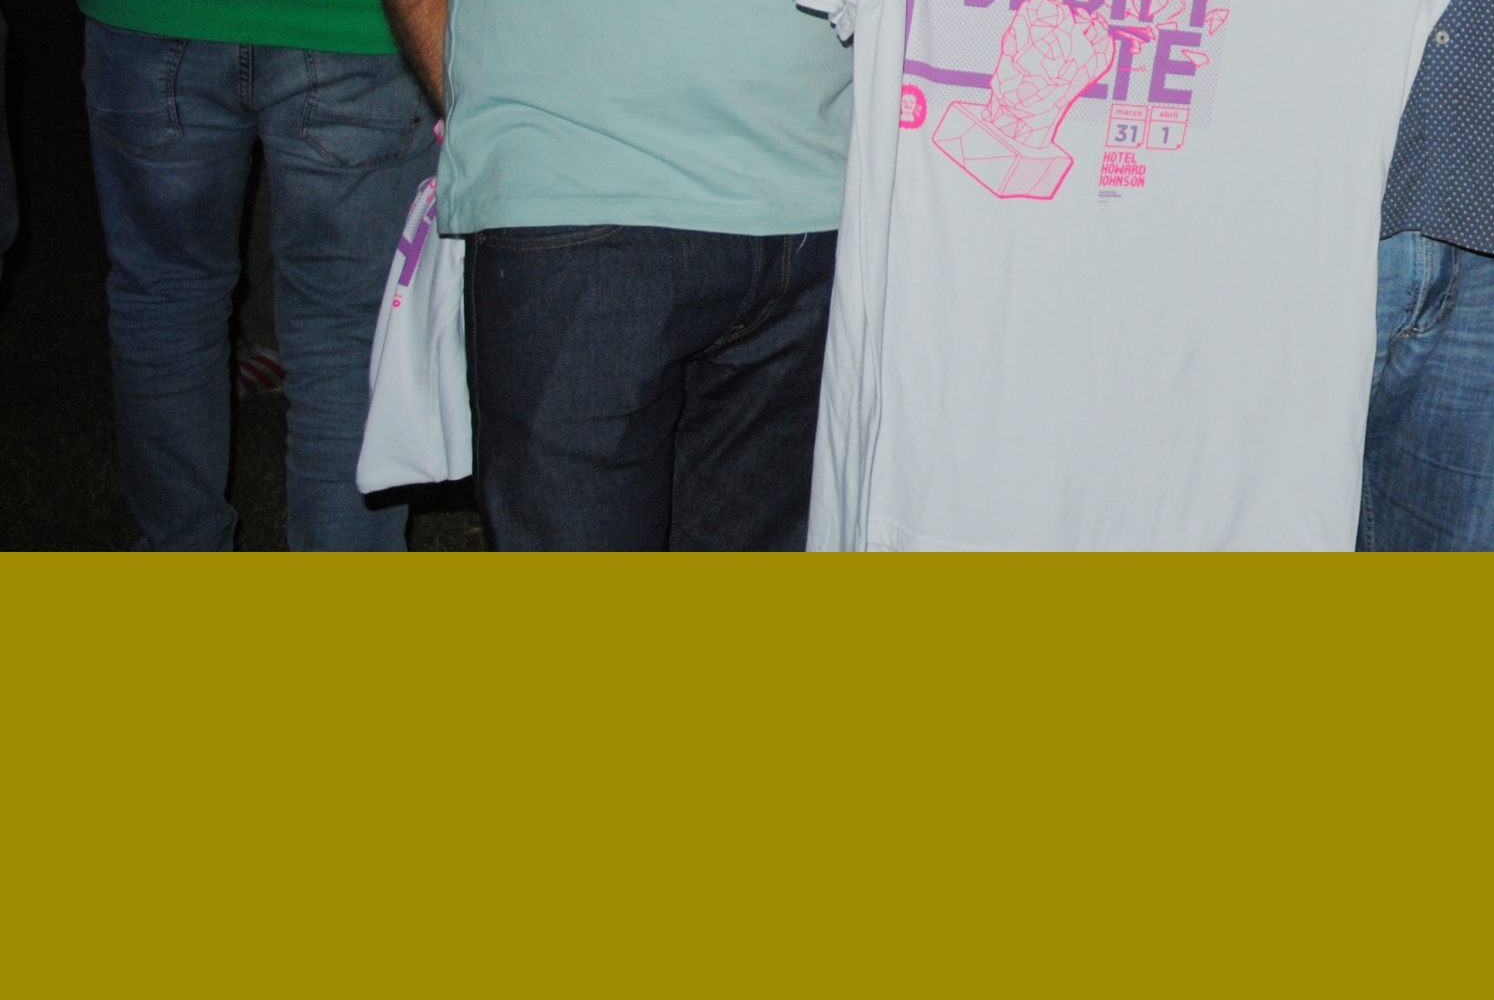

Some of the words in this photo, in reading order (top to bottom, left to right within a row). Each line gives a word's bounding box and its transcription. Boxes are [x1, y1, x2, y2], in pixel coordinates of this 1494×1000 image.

[1080, 24, 1203, 105] TE
[1116, 109, 1143, 117] marzo
[1114, 124, 1138, 143] 31
[1162, 126, 1169, 144] 1
[1103, 152, 1137, 163] HOTEL
[1101, 163, 1147, 175] HOWARD
[1098, 174, 1146, 187] JOHNSON
